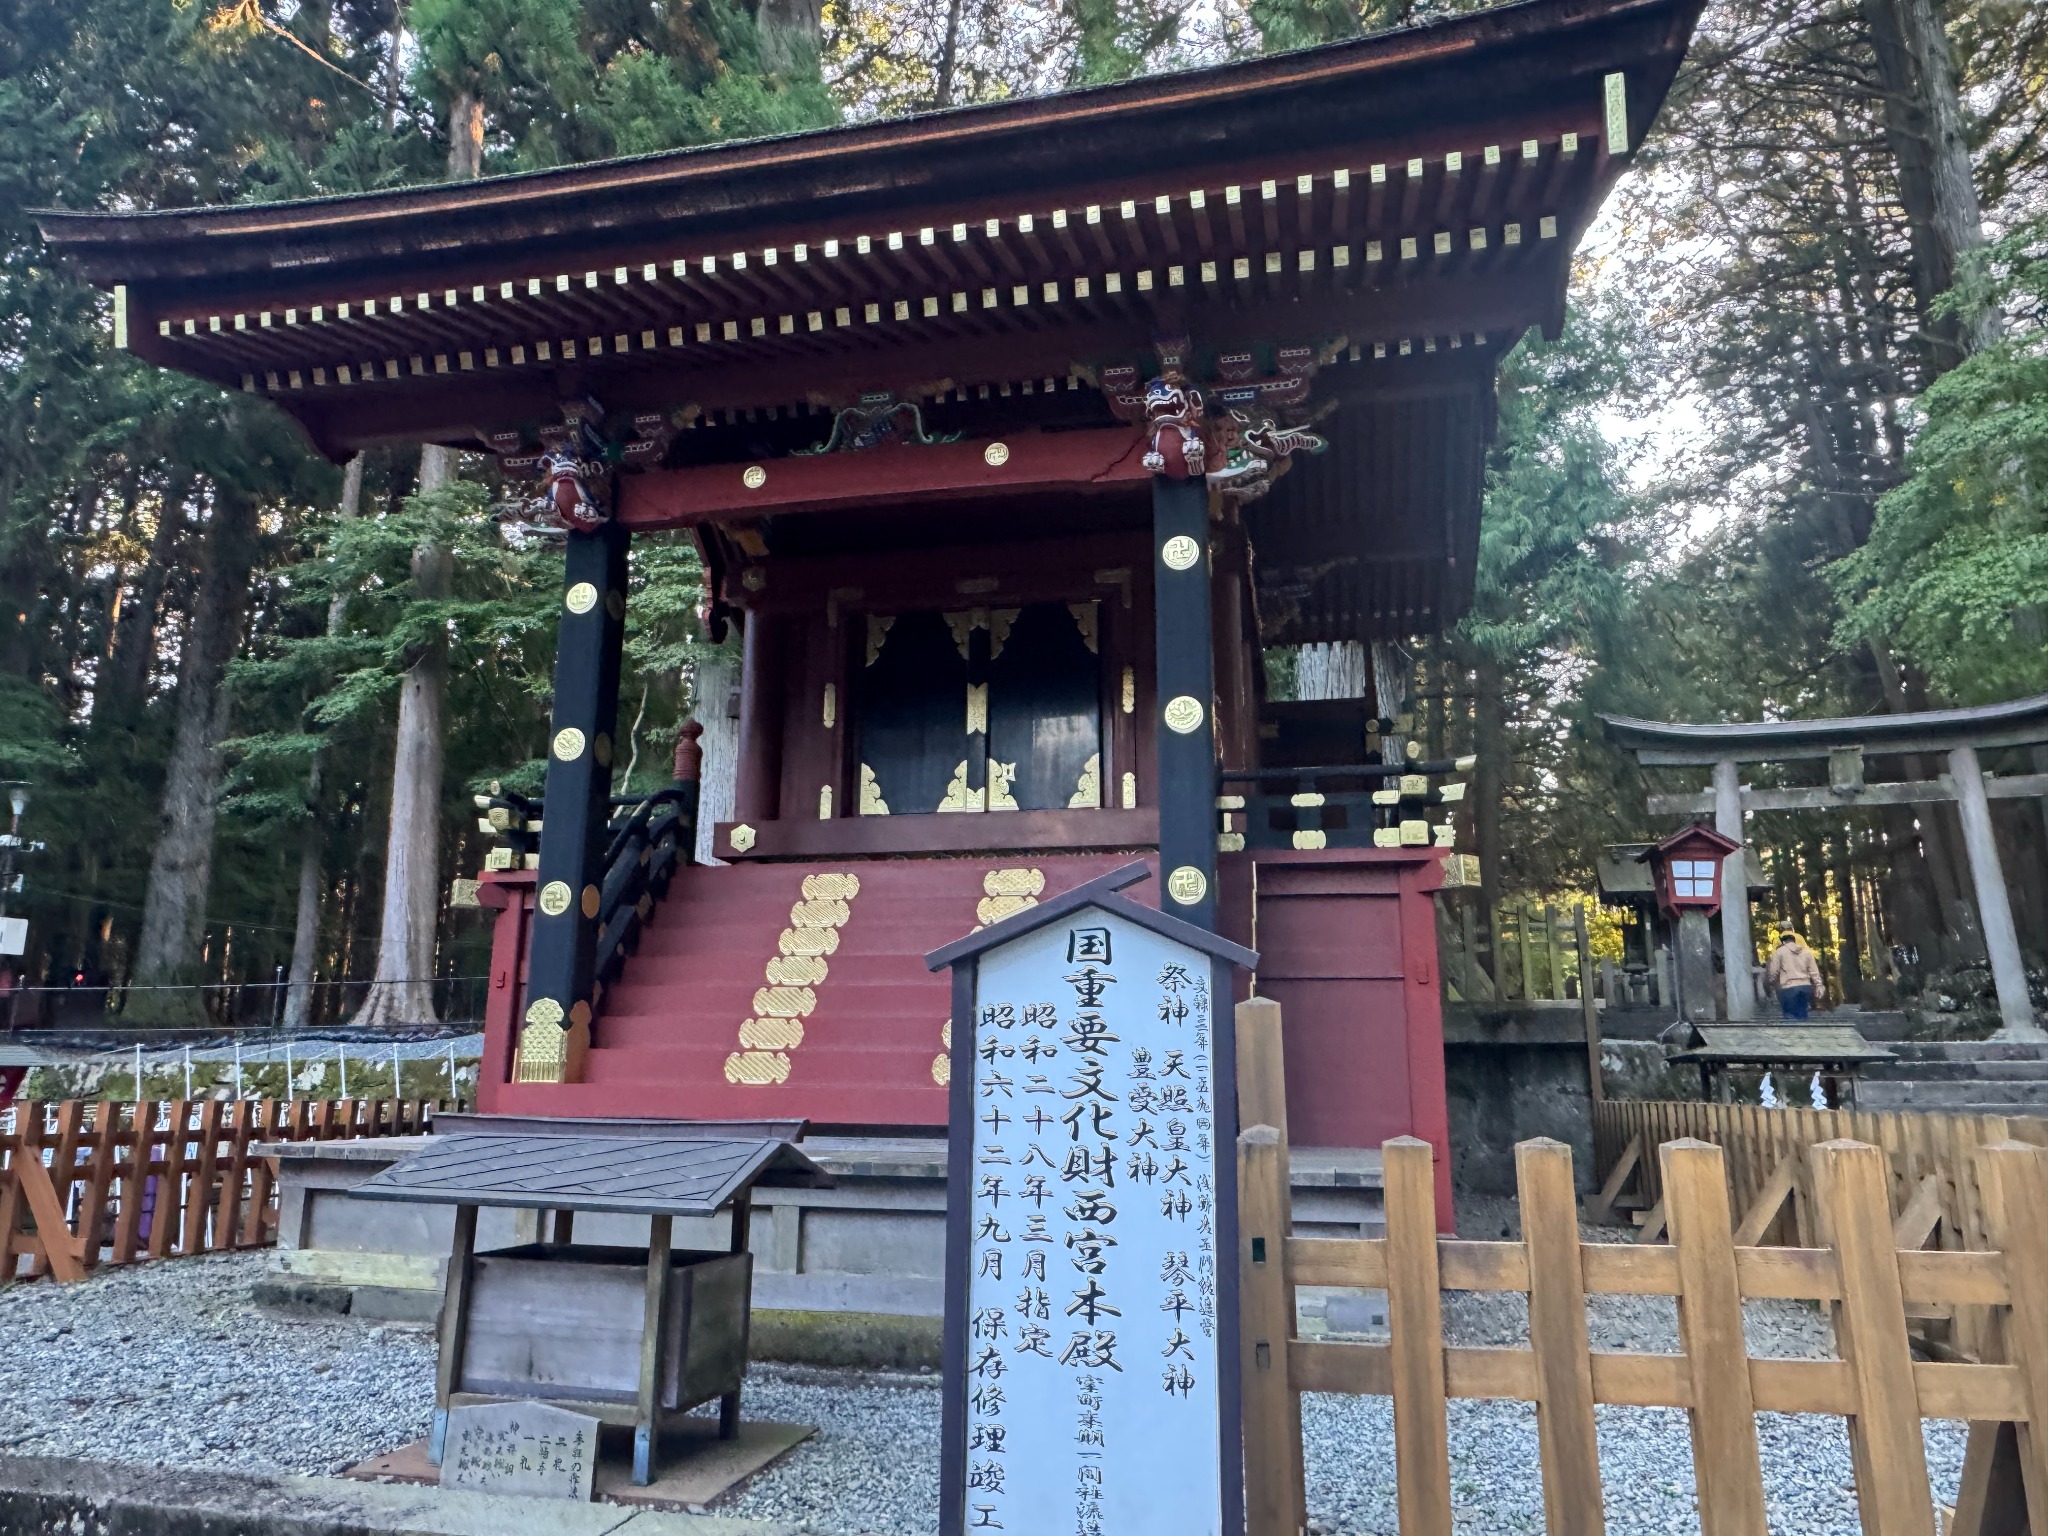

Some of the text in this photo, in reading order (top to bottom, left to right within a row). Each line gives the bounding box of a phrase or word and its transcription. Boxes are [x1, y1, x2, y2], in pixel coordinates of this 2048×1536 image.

[969, 1002, 1016, 1530] 昭和六十二年九月 保存修理竣工
[1014, 1002, 1059, 1358] 昭和二十八年三月指定
[1058, 926, 1124, 1373] 国重要文化財西宮本殿
[1126, 1047, 1159, 1186] 豊受大神
[1156, 961, 1196, 1400] 祭神 天照皇大神 琴平大神
